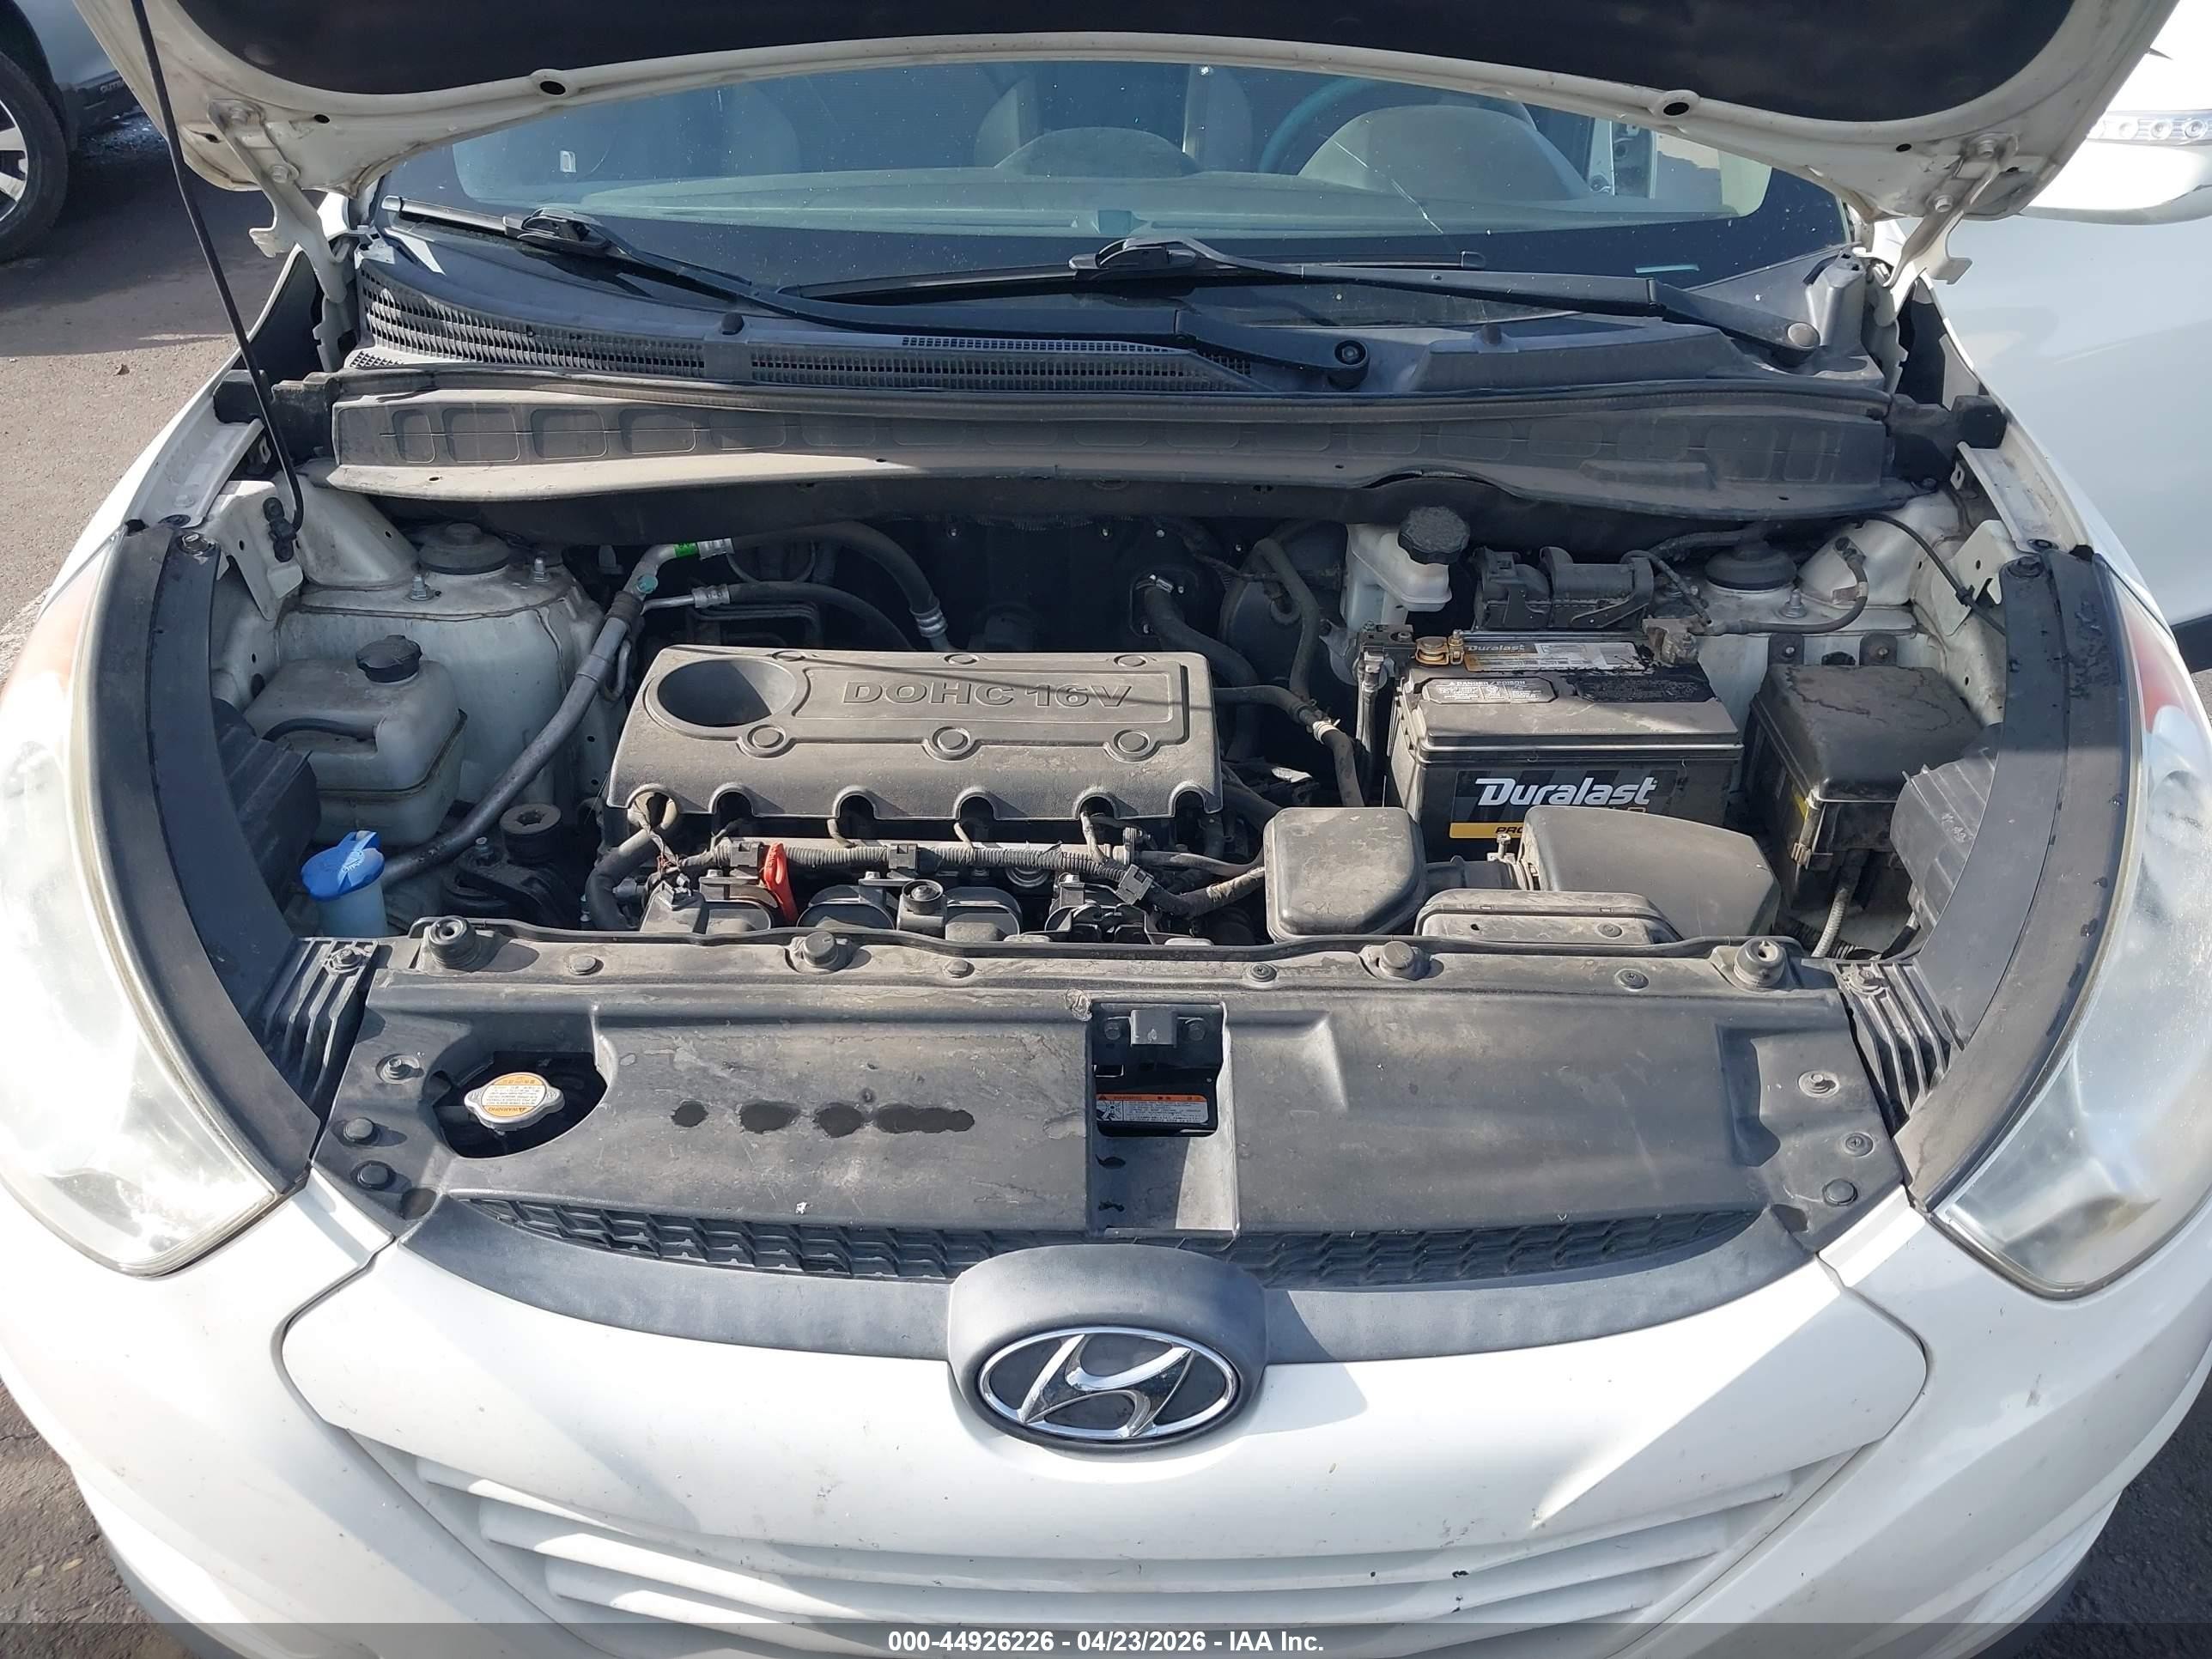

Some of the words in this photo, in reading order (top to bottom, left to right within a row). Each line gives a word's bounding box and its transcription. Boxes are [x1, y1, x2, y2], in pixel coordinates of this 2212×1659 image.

[843, 681, 1015, 706] DOHC
[1026, 684, 1133, 708] 16V
[1474, 776, 1658, 806] Duralast
